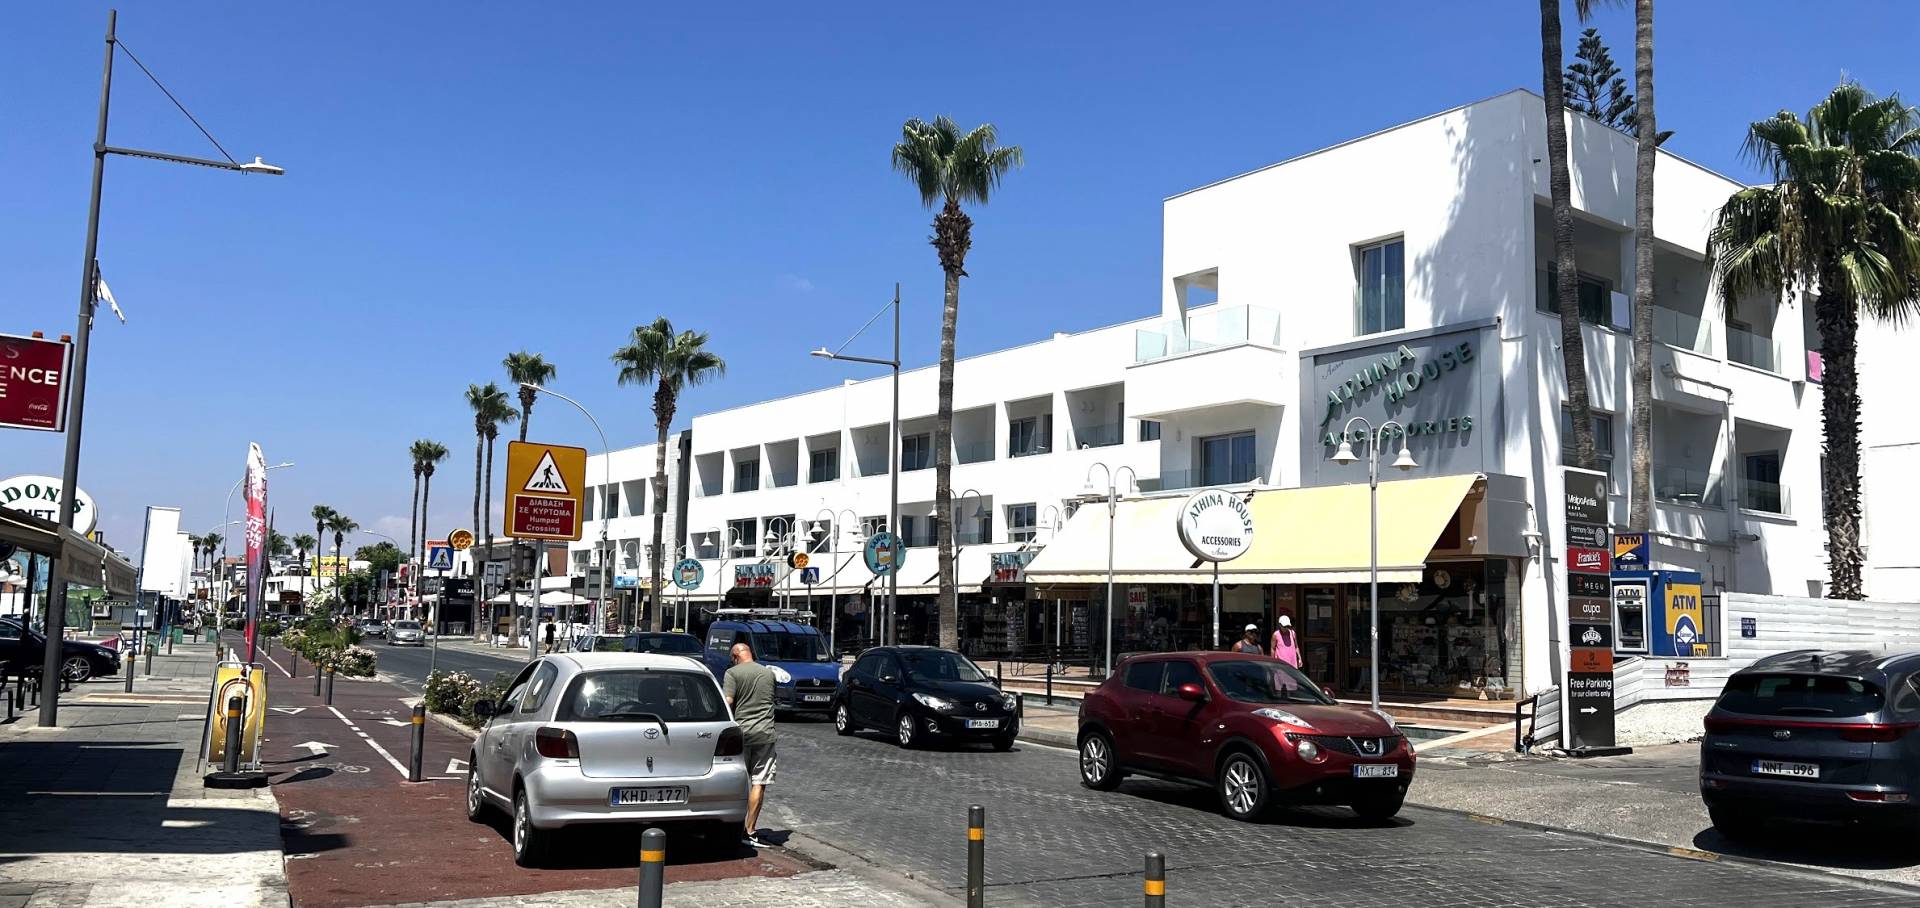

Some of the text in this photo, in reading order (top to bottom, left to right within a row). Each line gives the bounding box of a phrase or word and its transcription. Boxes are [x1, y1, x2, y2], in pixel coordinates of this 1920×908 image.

[1319, 341, 1474, 427] ATHINA HOUSE
[529, 499, 564, 508] ΔΙΑΒΑΣΗ
[519, 506, 571, 517] ΣΕ ΚΥΡΤΩΜΑ
[1190, 494, 1253, 535] ATHINA HOUSE
[529, 515, 560, 524] Humped
[526, 524, 560, 534] Crossing
[1201, 535, 1241, 547] ACCESSORIES
[1618, 536, 1641, 545] ATM
[1584, 582, 1604, 590] MEGU
[1129, 591, 1147, 602] SALE
[1616, 589, 1640, 597] ATM
[1672, 595, 1697, 610] ATM
[1570, 677, 1612, 690] Free Parking
[1600, 690, 1611, 698] only
[1382, 767, 1396, 776] 834
[1762, 762, 1814, 776] NNT 096
[621, 789, 682, 802] KHD 177
